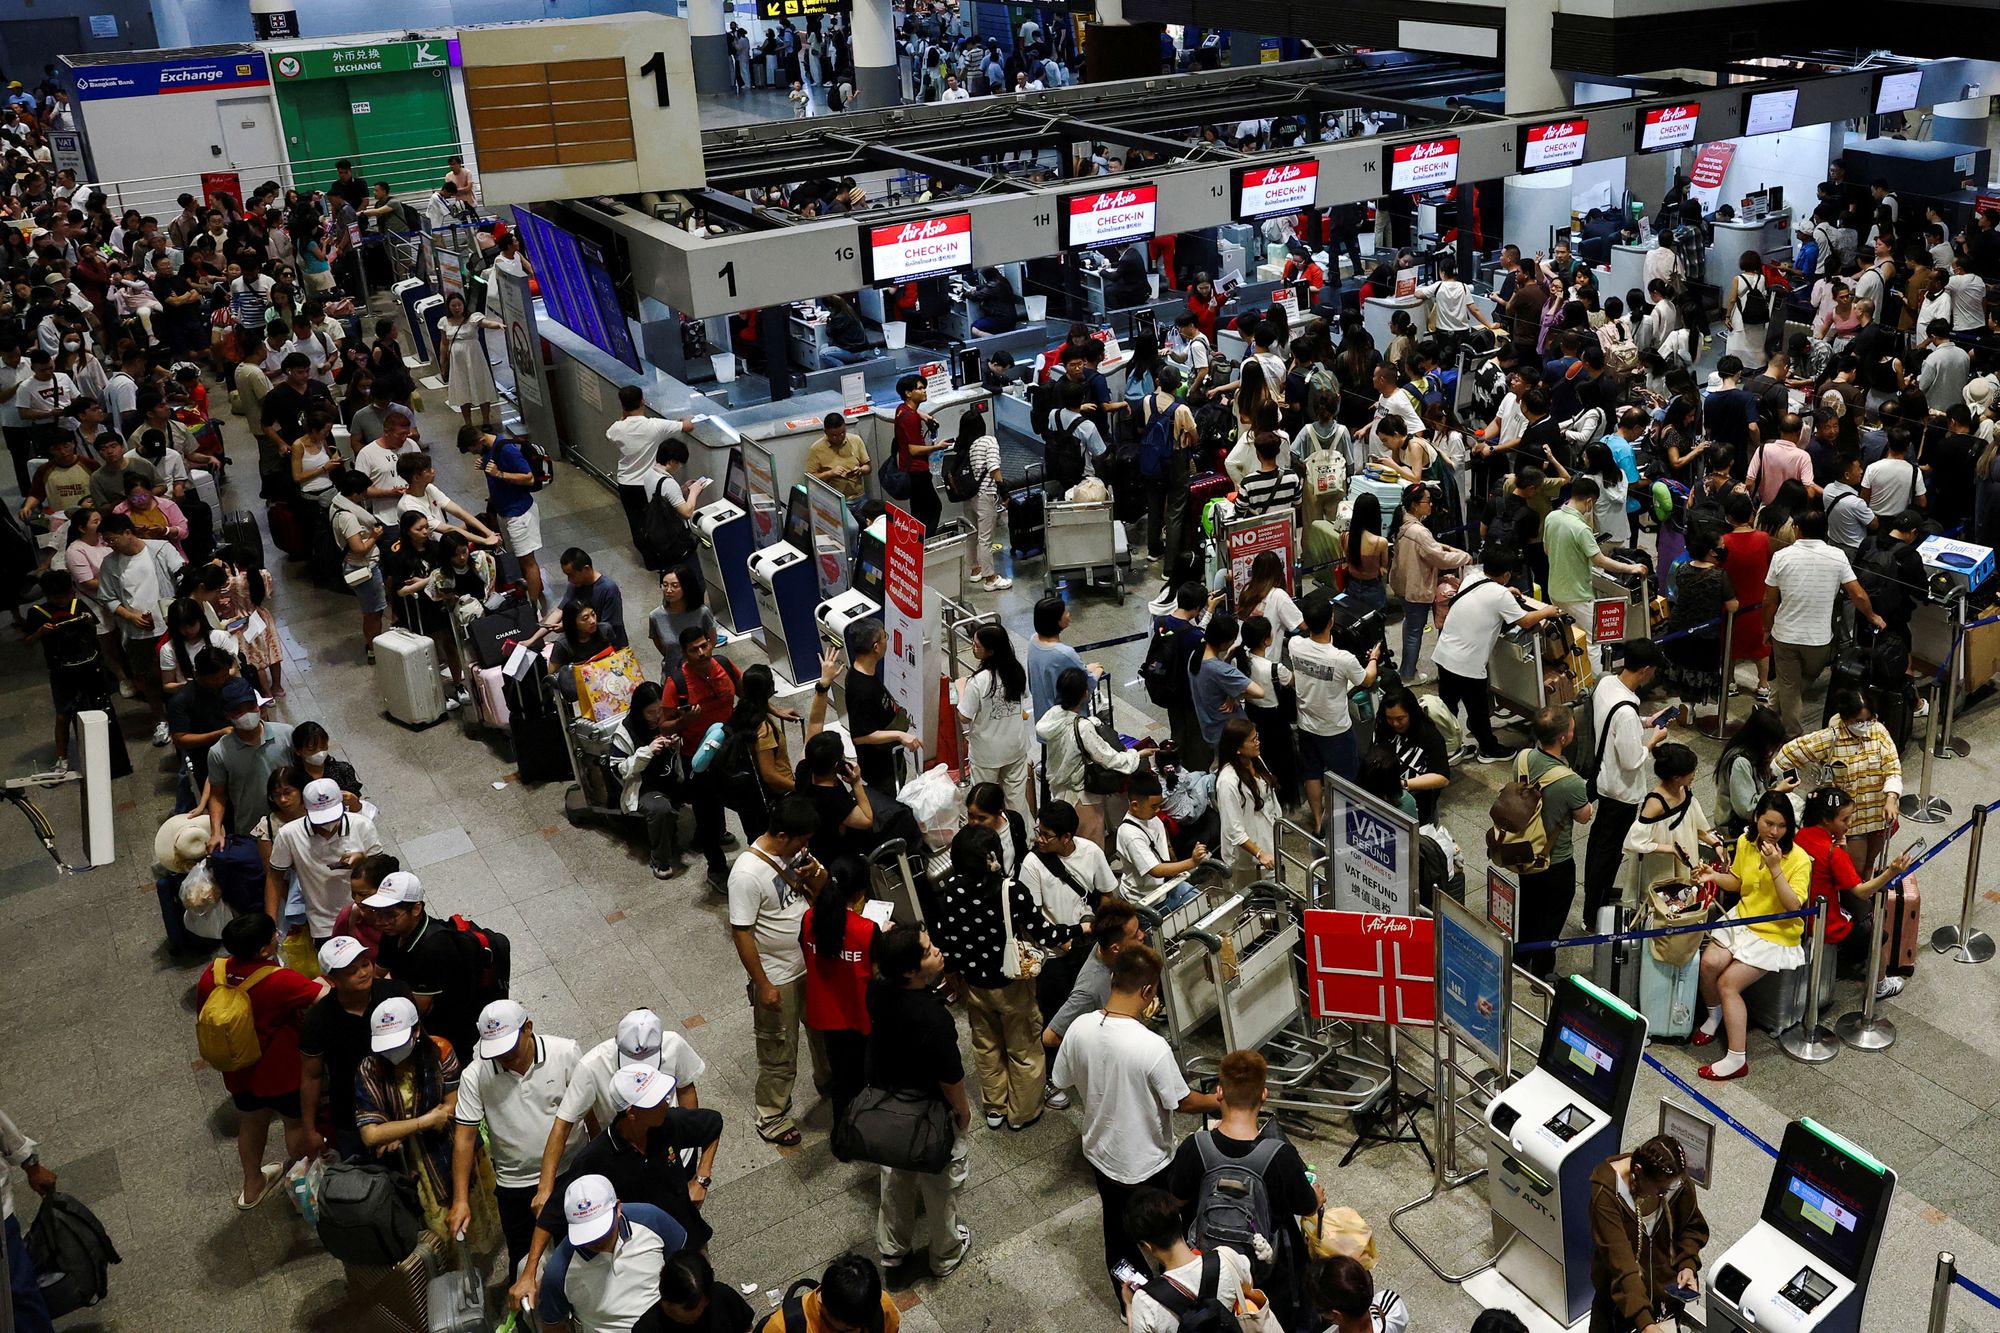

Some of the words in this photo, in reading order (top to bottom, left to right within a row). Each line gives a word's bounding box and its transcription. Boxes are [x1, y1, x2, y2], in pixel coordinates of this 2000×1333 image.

[332, 48, 380, 62] 外币兑换
[334, 62, 382, 73] EXCHANGE
[160, 69, 223, 83] Exchange
[640, 51, 670, 107] 1
[1728, 107, 1737, 116] 1N
[1622, 121, 1633, 134] 1M
[1660, 123, 1690, 135] CHECK-IN
[1502, 142, 1513, 152] 1L
[1544, 141, 1578, 153] CHECK-IN
[1363, 161, 1376, 173] 1K
[1413, 161, 1449, 174] CHECK-IN
[1210, 185, 1223, 197] 1J
[1265, 185, 1307, 199] CHECK-IN
[1033, 213, 1050, 227] 1H
[1097, 211, 1145, 226] CHECK-IN
[834, 247, 854, 262] 1G
[904, 242, 958, 259] CHECK-IN
[718, 261, 737, 297] 1
[1231, 530, 1257, 548] NO
[1265, 532, 1285, 540] AIRCRAFT
[495, 629, 521, 640] CHANEL
[1351, 809, 1390, 850] VAT
[1352, 834, 1390, 865] REFUND
[1350, 850, 1362, 861] FOR
[1364, 859, 1392, 880] TOURISTS
[1344, 862, 1361, 879] VAT
[1362, 874, 1398, 903] REFUND
[1522, 1192, 1549, 1216] AOT
